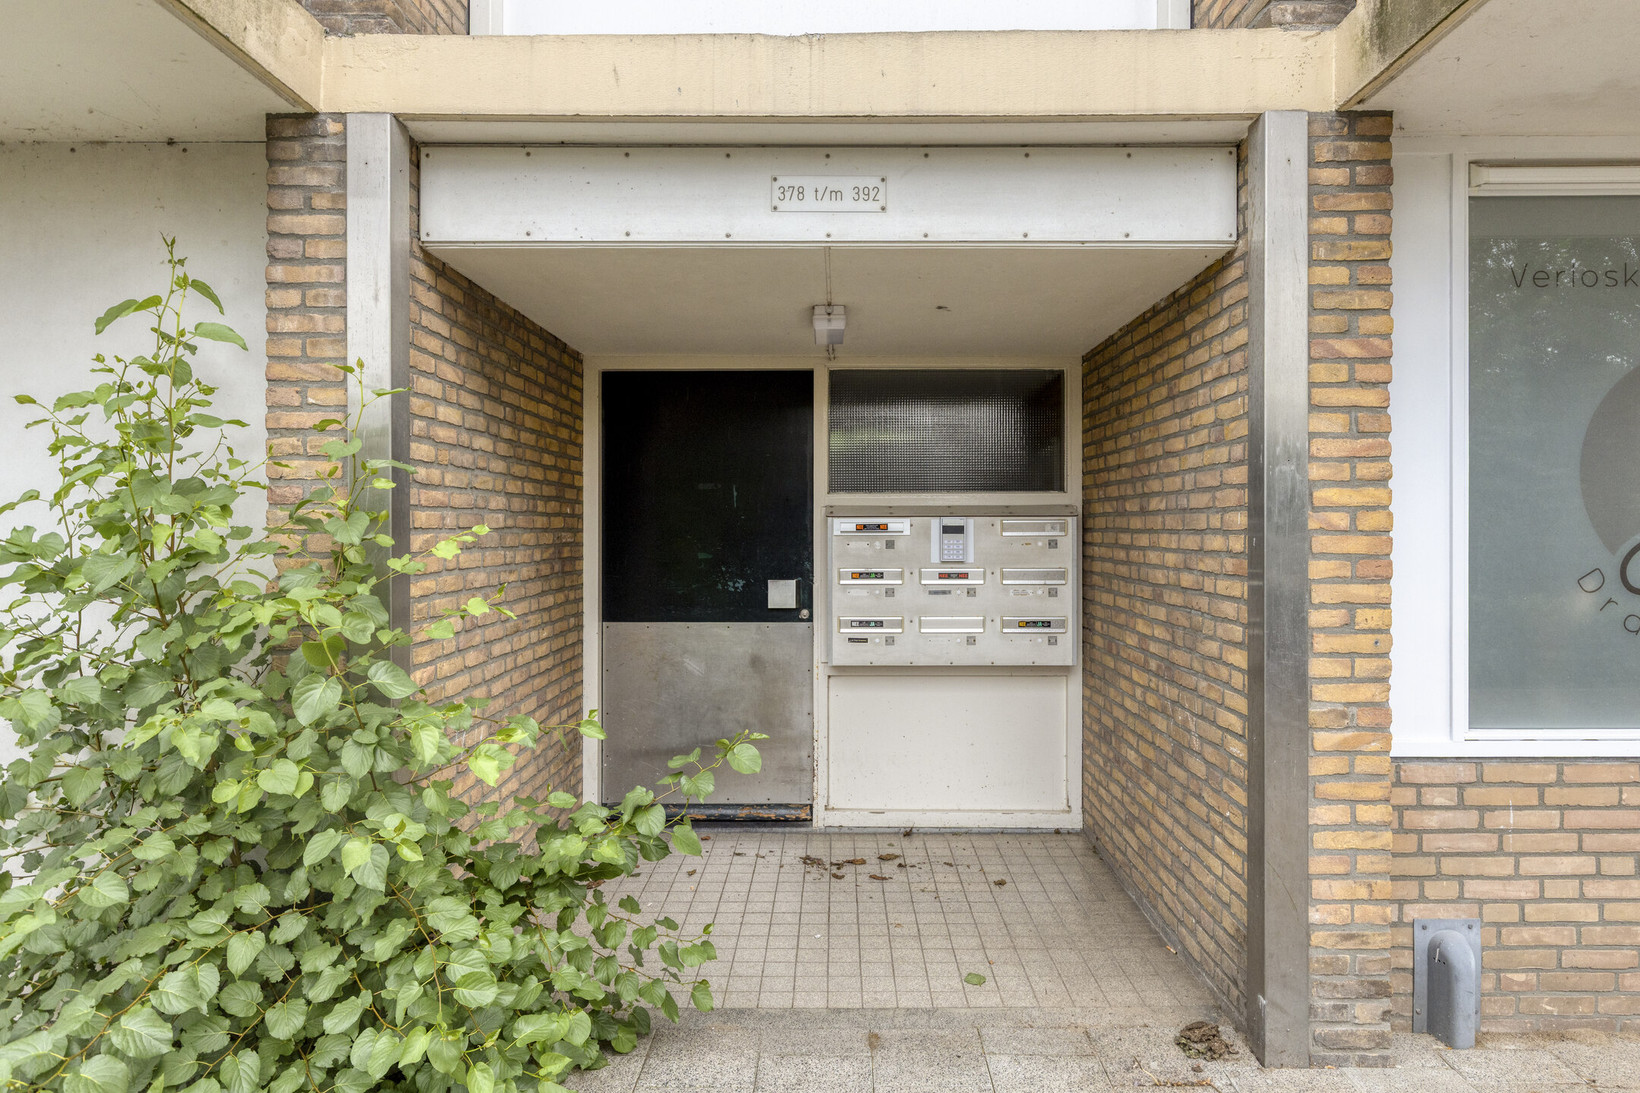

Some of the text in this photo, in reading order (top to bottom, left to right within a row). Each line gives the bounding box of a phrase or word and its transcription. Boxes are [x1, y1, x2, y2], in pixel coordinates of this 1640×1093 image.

[778, 186, 880, 201] 378 t/m 392
